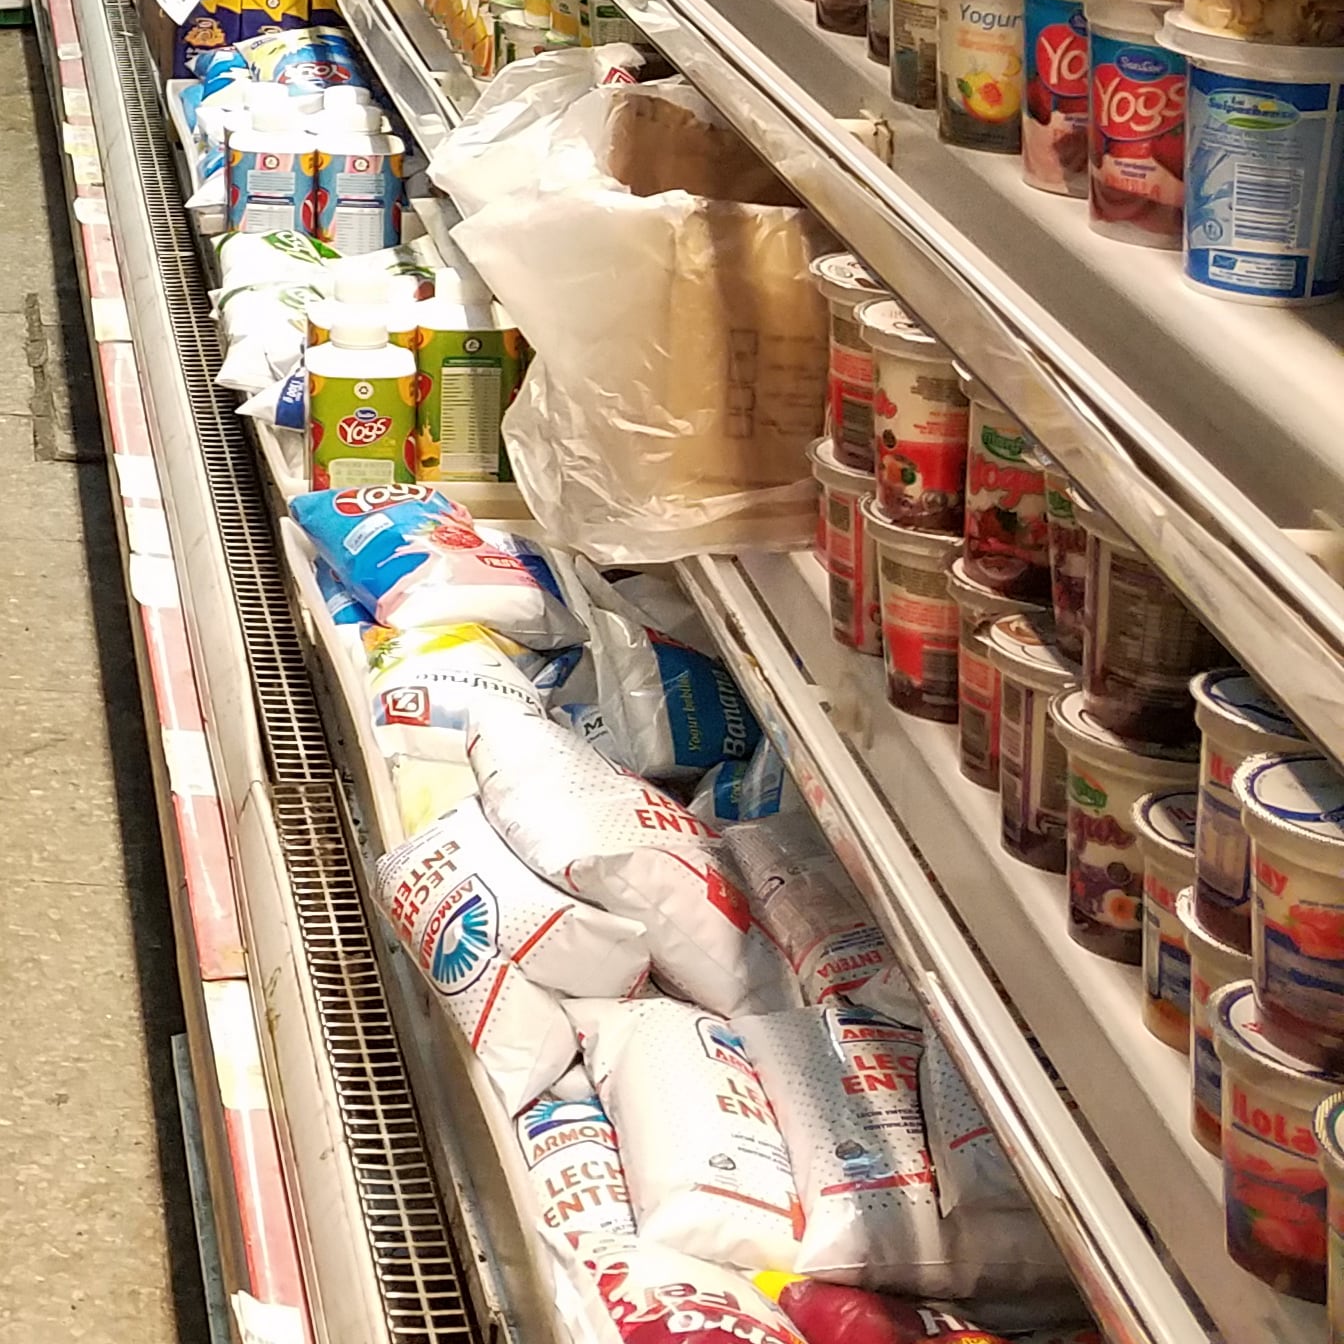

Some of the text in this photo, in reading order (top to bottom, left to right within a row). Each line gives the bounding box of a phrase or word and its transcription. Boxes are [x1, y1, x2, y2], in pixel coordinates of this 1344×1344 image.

[959, 3, 1023, 31] Yogur
[342, 419, 389, 443] Yogs
[817, 948, 883, 979] ENTERA
